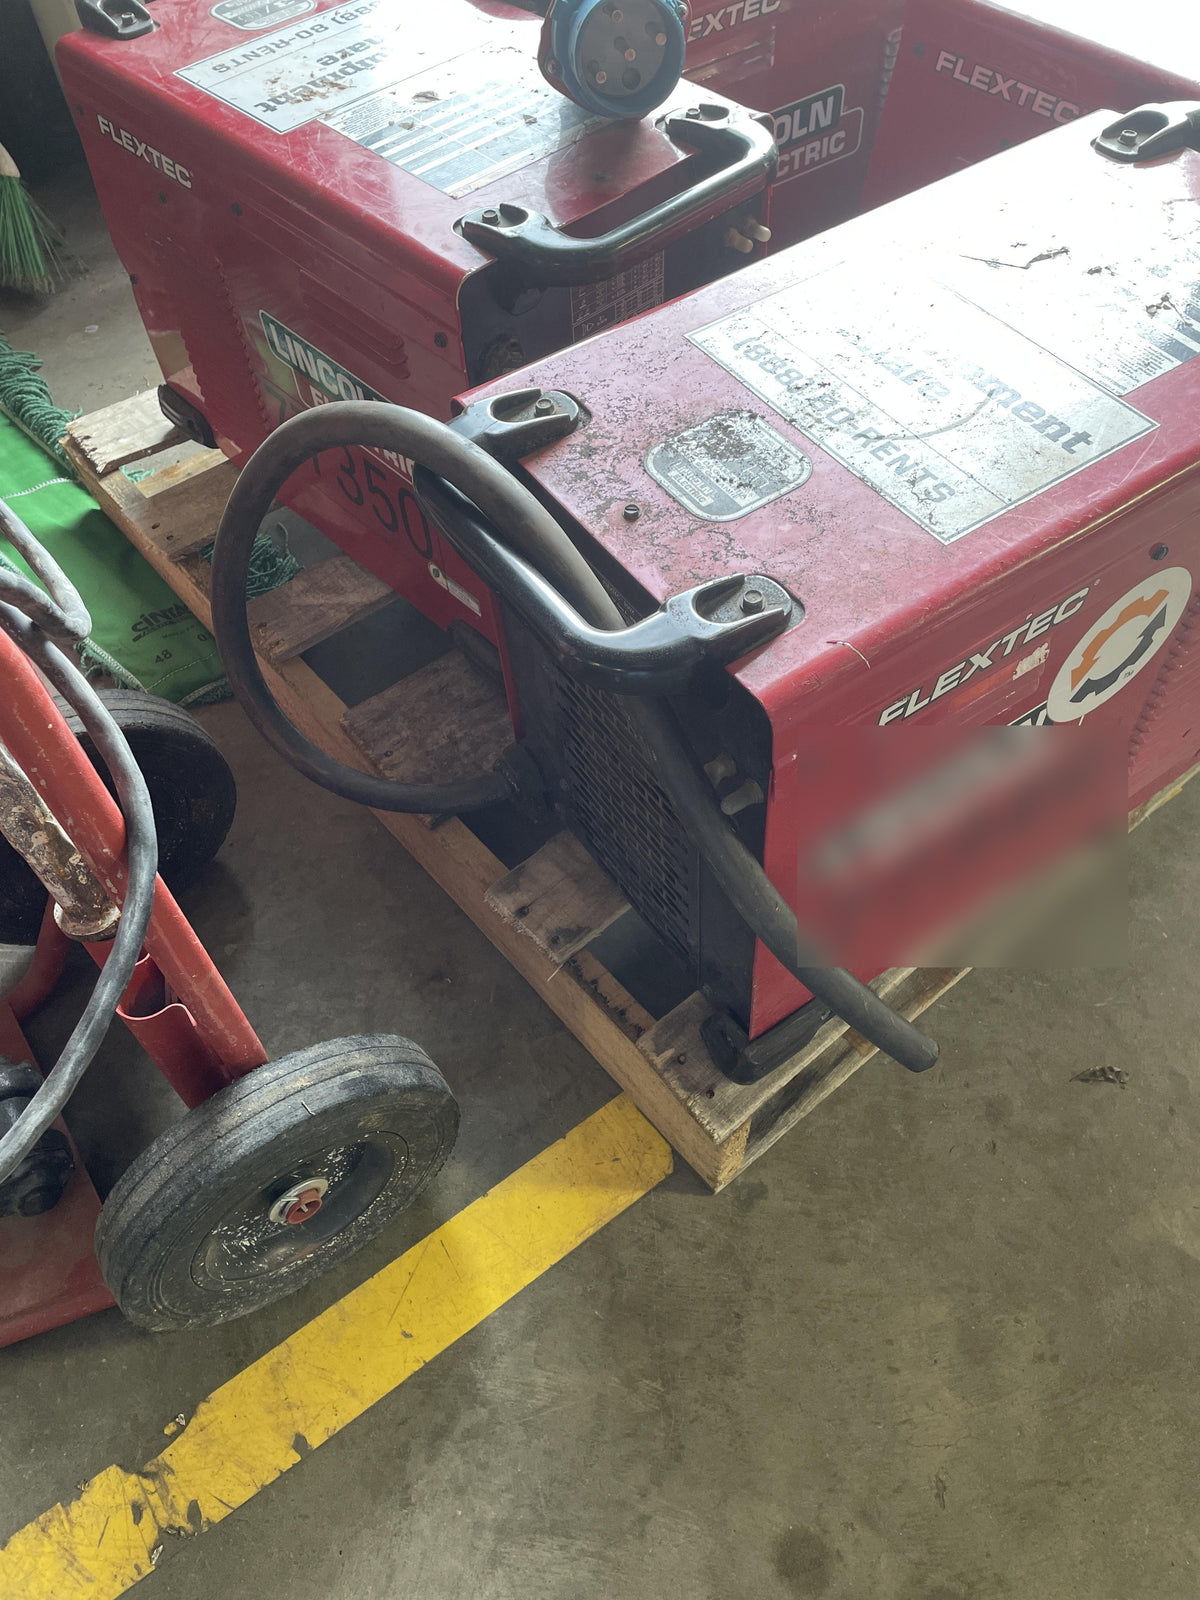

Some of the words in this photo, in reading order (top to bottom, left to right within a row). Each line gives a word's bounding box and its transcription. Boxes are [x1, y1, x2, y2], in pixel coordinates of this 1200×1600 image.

[211, 22, 329, 73] 80-RENTS
[687, 0, 782, 43] EXTEC
[935, 50, 1081, 125] FLEXTEC
[96, 114, 192, 189] FLEXTEC
[776, 129, 847, 177] CTRIC
[268, 322, 378, 402] LINCO
[806, 388, 956, 504] 80-RENTS
[154, 649, 173, 665] 48
[877, 586, 1091, 727] FLEXTEC
